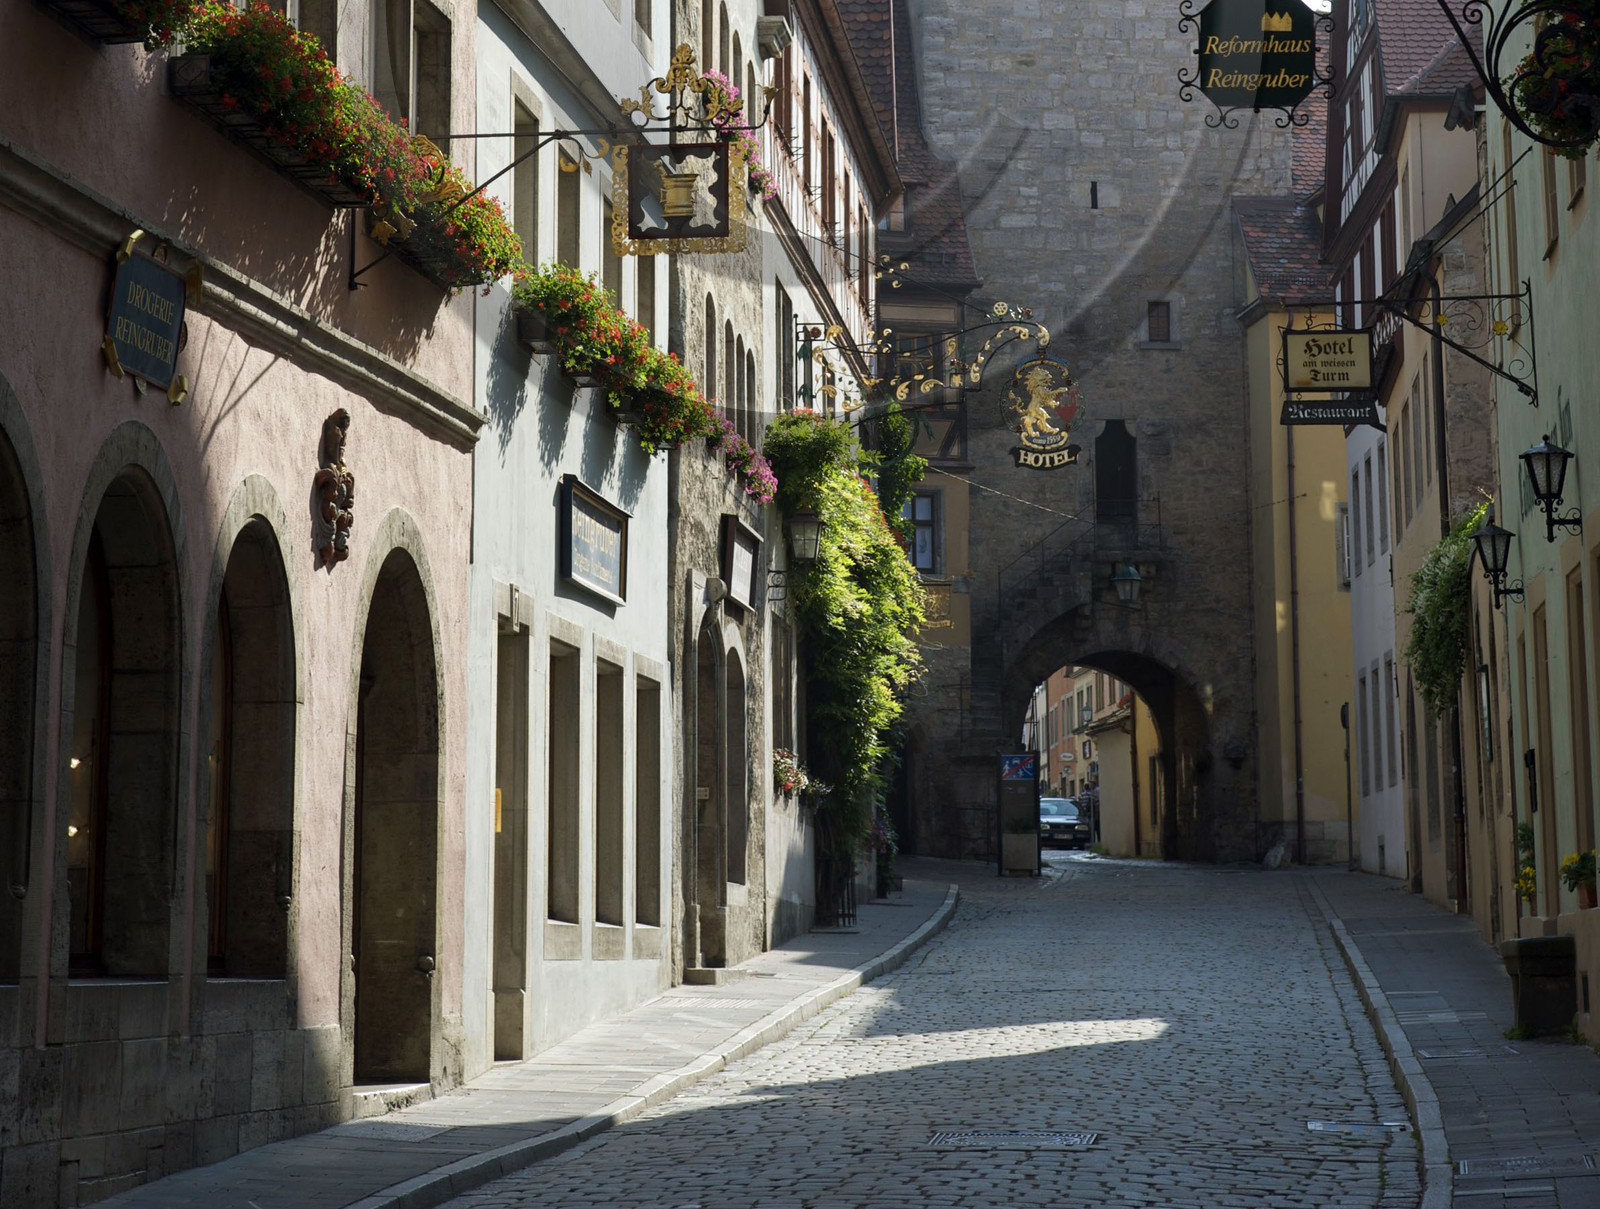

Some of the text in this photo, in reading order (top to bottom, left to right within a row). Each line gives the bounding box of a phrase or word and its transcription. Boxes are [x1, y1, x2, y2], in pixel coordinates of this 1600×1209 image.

[1204, 34, 1311, 57] Reformhaus
[1206, 68, 1309, 91] Reingruber
[127, 281, 174, 326] DROGERIE
[115, 316, 173, 365] REINGRUBER
[1304, 337, 1354, 358] Hotel
[1321, 358, 1356, 367] weissen
[1309, 369, 1350, 382] Turm
[1288, 404, 1371, 419] Restaurant
[1019, 449, 1075, 468] HOTEL
